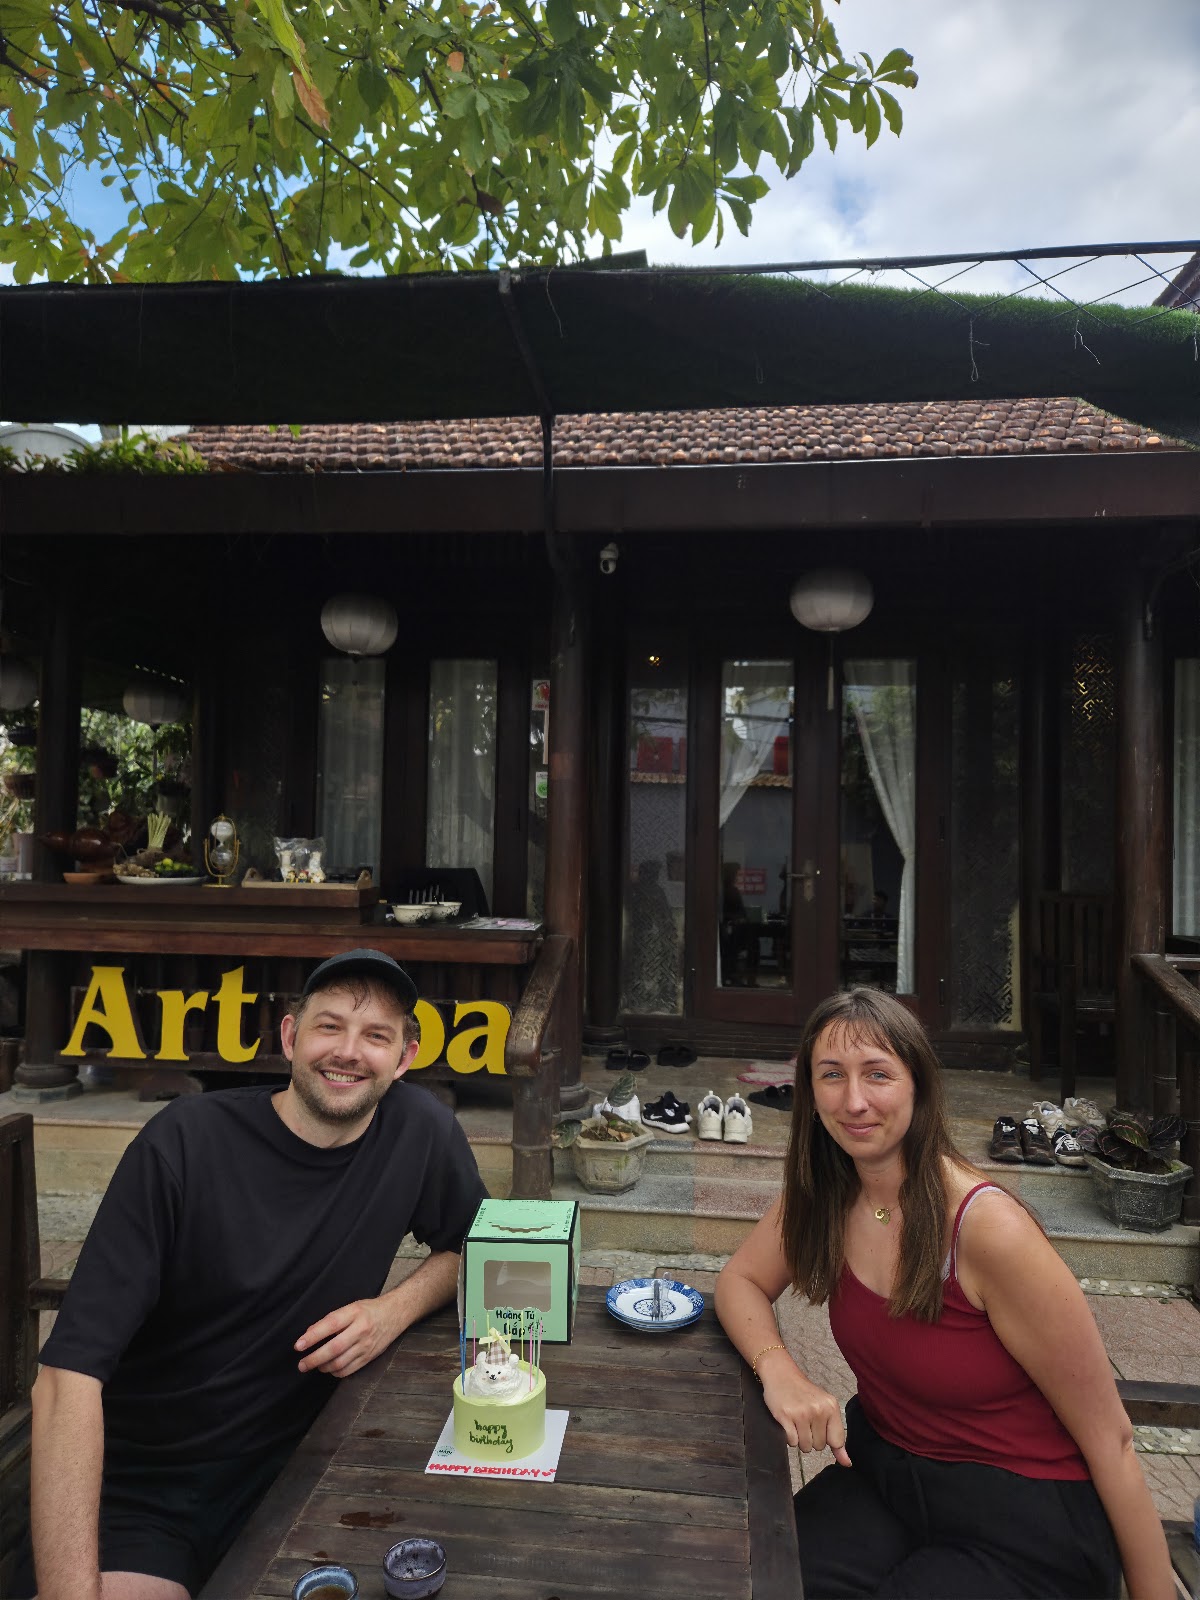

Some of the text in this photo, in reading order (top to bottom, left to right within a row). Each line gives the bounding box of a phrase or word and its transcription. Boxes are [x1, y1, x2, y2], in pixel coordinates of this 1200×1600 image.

[61, 965, 261, 1063] Art
[474, 1419, 507, 1438] happy
[469, 1431, 513, 1453] birthday
[428, 1463, 471, 1473] HAPPY
